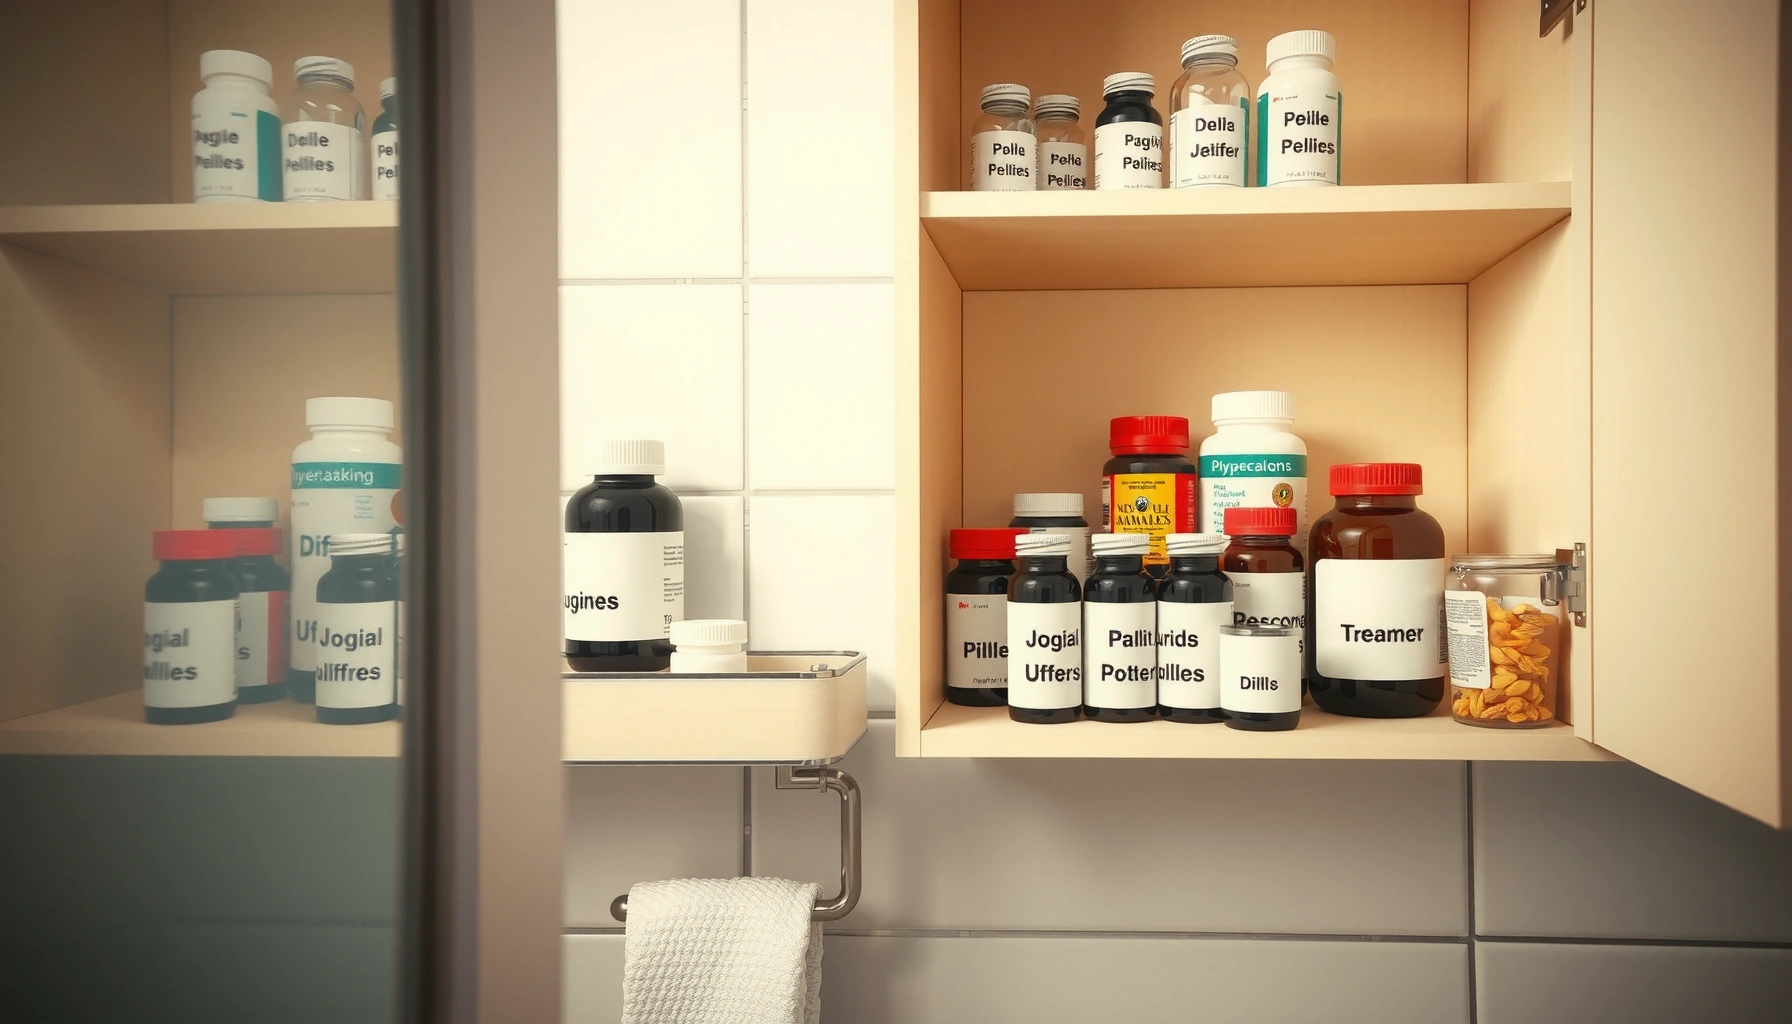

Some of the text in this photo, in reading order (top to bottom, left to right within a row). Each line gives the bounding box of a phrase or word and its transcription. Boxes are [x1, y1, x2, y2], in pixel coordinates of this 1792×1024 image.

[1195, 117, 1235, 132] Della
[320, 627, 382, 652] Jogial
[1026, 628, 1079, 652] Jogial
[1340, 623, 1424, 643] Treamer
[1025, 663, 1080, 682] Uffers
